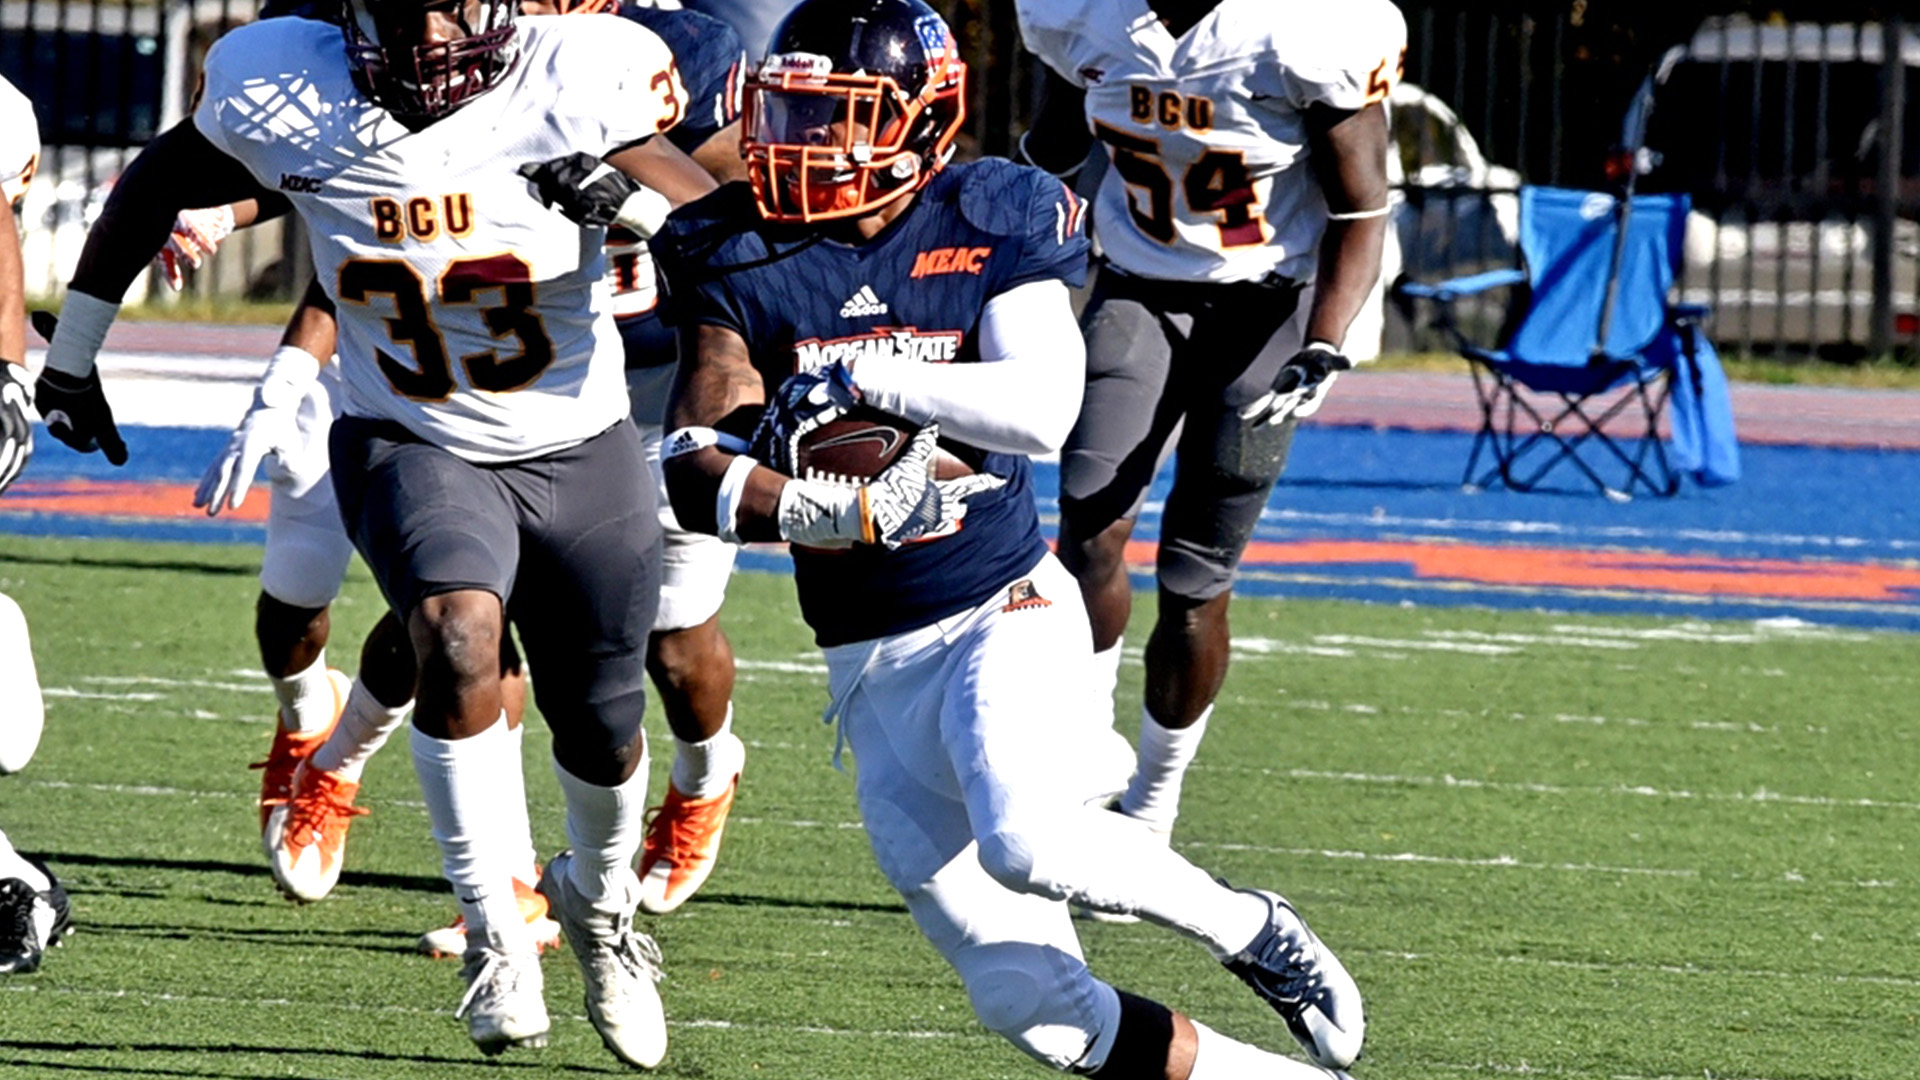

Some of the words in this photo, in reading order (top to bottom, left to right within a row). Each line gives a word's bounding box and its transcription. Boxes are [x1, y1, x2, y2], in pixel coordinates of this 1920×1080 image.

[649, 58, 687, 131] 3
[1363, 45, 1408, 110] 5
[1130, 83, 1214, 136] BCU
[1092, 117, 1266, 251] 54
[369, 193, 475, 244] BCU
[909, 247, 992, 280] MEAC
[337, 248, 556, 403] 33
[839, 303, 889, 319] adidas
[890, 331, 959, 362] STATE
